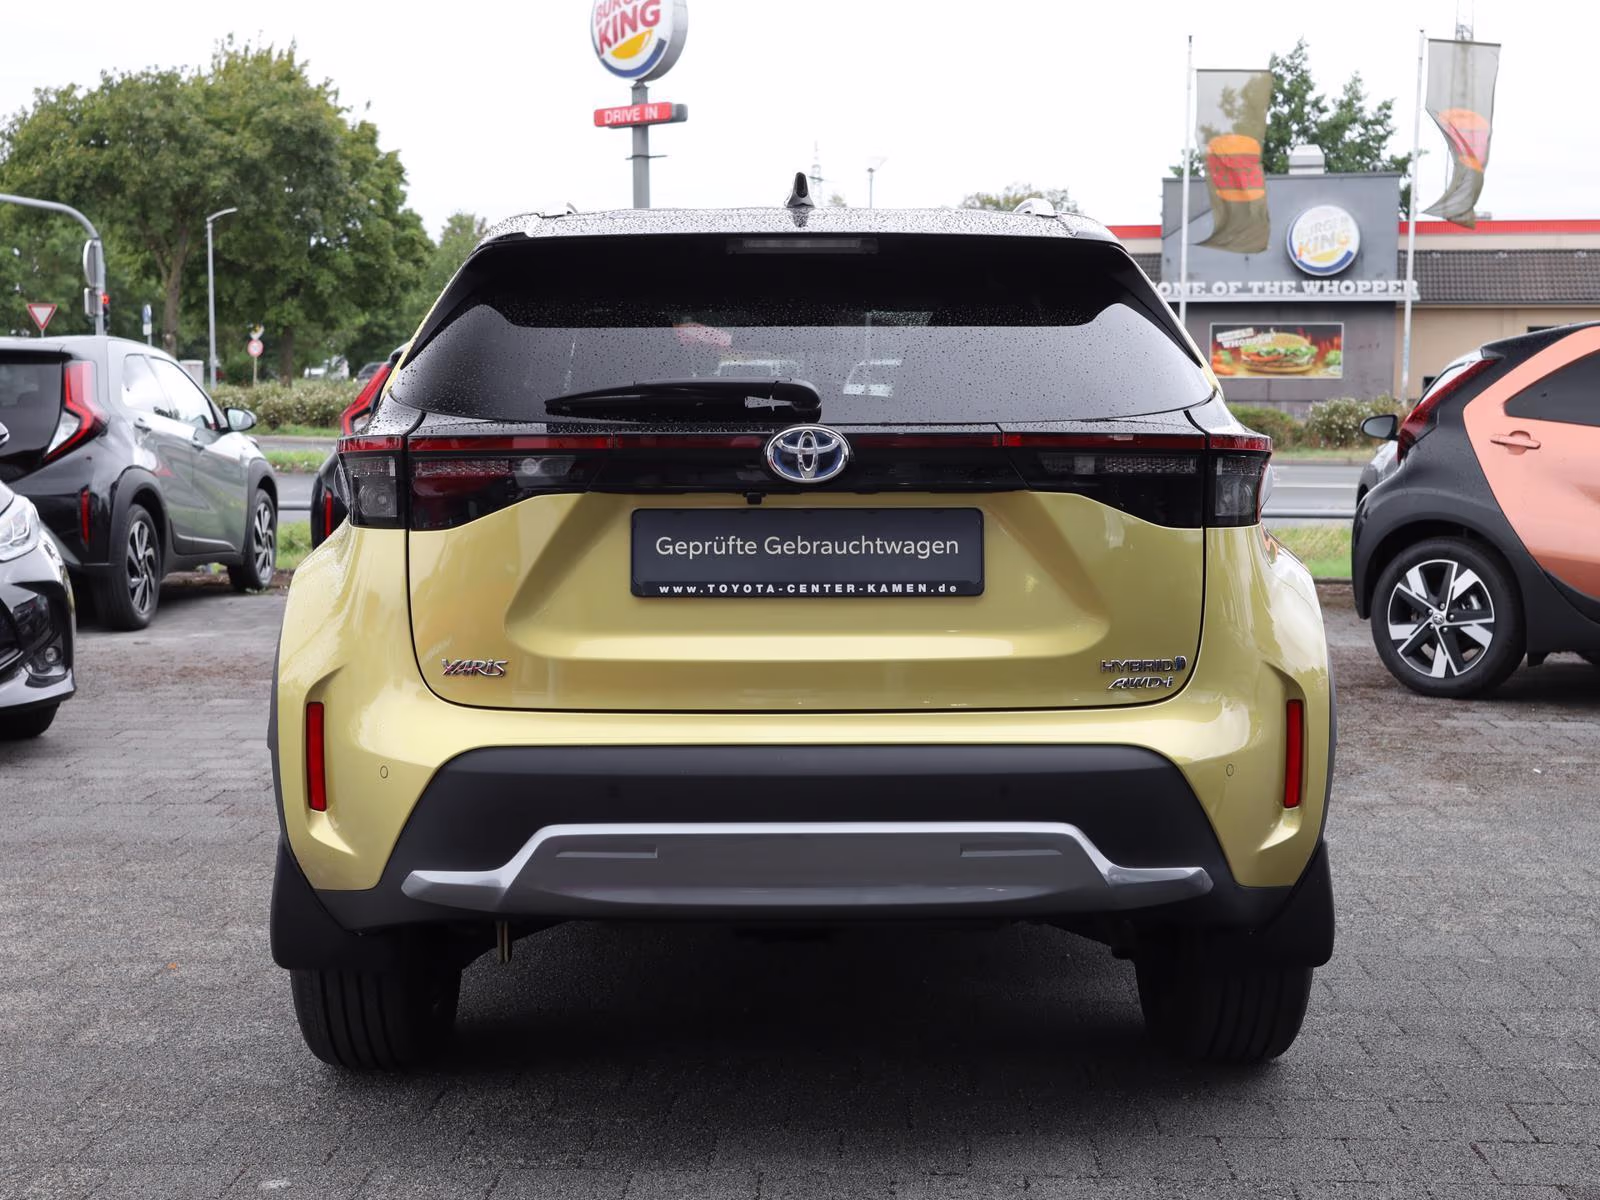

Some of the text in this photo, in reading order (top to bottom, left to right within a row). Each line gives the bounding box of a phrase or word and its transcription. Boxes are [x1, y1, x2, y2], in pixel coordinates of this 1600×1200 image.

[598, 0, 661, 56] KING
[604, 105, 659, 124] DRIVE IN
[1152, 279, 1419, 298] OME OF THE WHOPPER
[655, 535, 959, 560] Geprüfte Gebrauchtwagen
[658, 583, 957, 594] www.TOYOTA-CENTER-KAMEN.de
[1101, 659, 1174, 673] HYBRID
